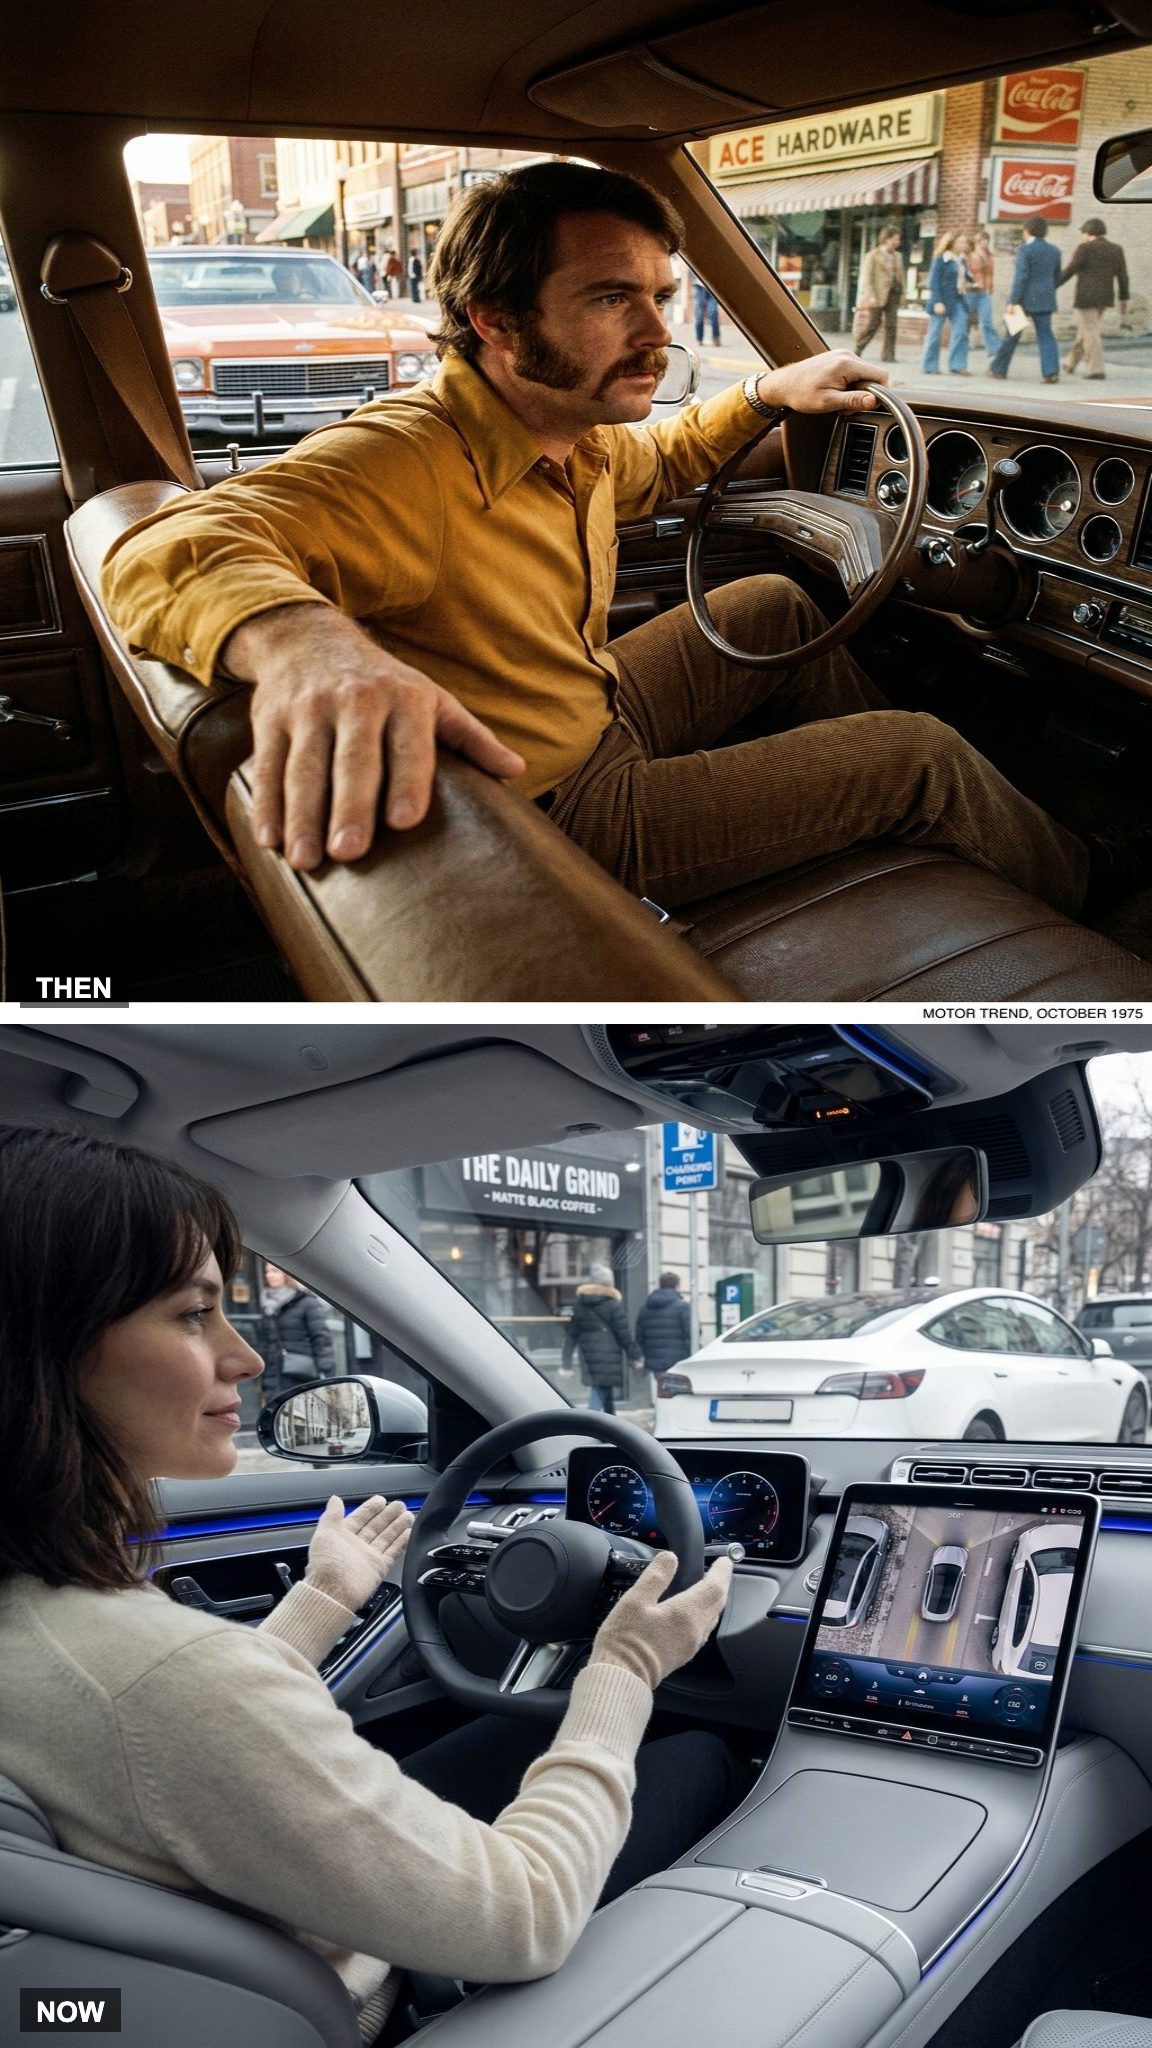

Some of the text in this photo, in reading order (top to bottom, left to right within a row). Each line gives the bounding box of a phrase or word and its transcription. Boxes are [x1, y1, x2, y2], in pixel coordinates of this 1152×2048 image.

[719, 109, 912, 168] ACE HARDWARE
[505, 1155, 560, 1192] DAILY
[565, 1165, 620, 1200] GRIND
[491, 1191, 526, 1206] MATTE
[527, 1195, 560, 1210] BLACK
[560, 1199, 597, 1214] COFFEE
[726, 1285, 738, 1301] P
